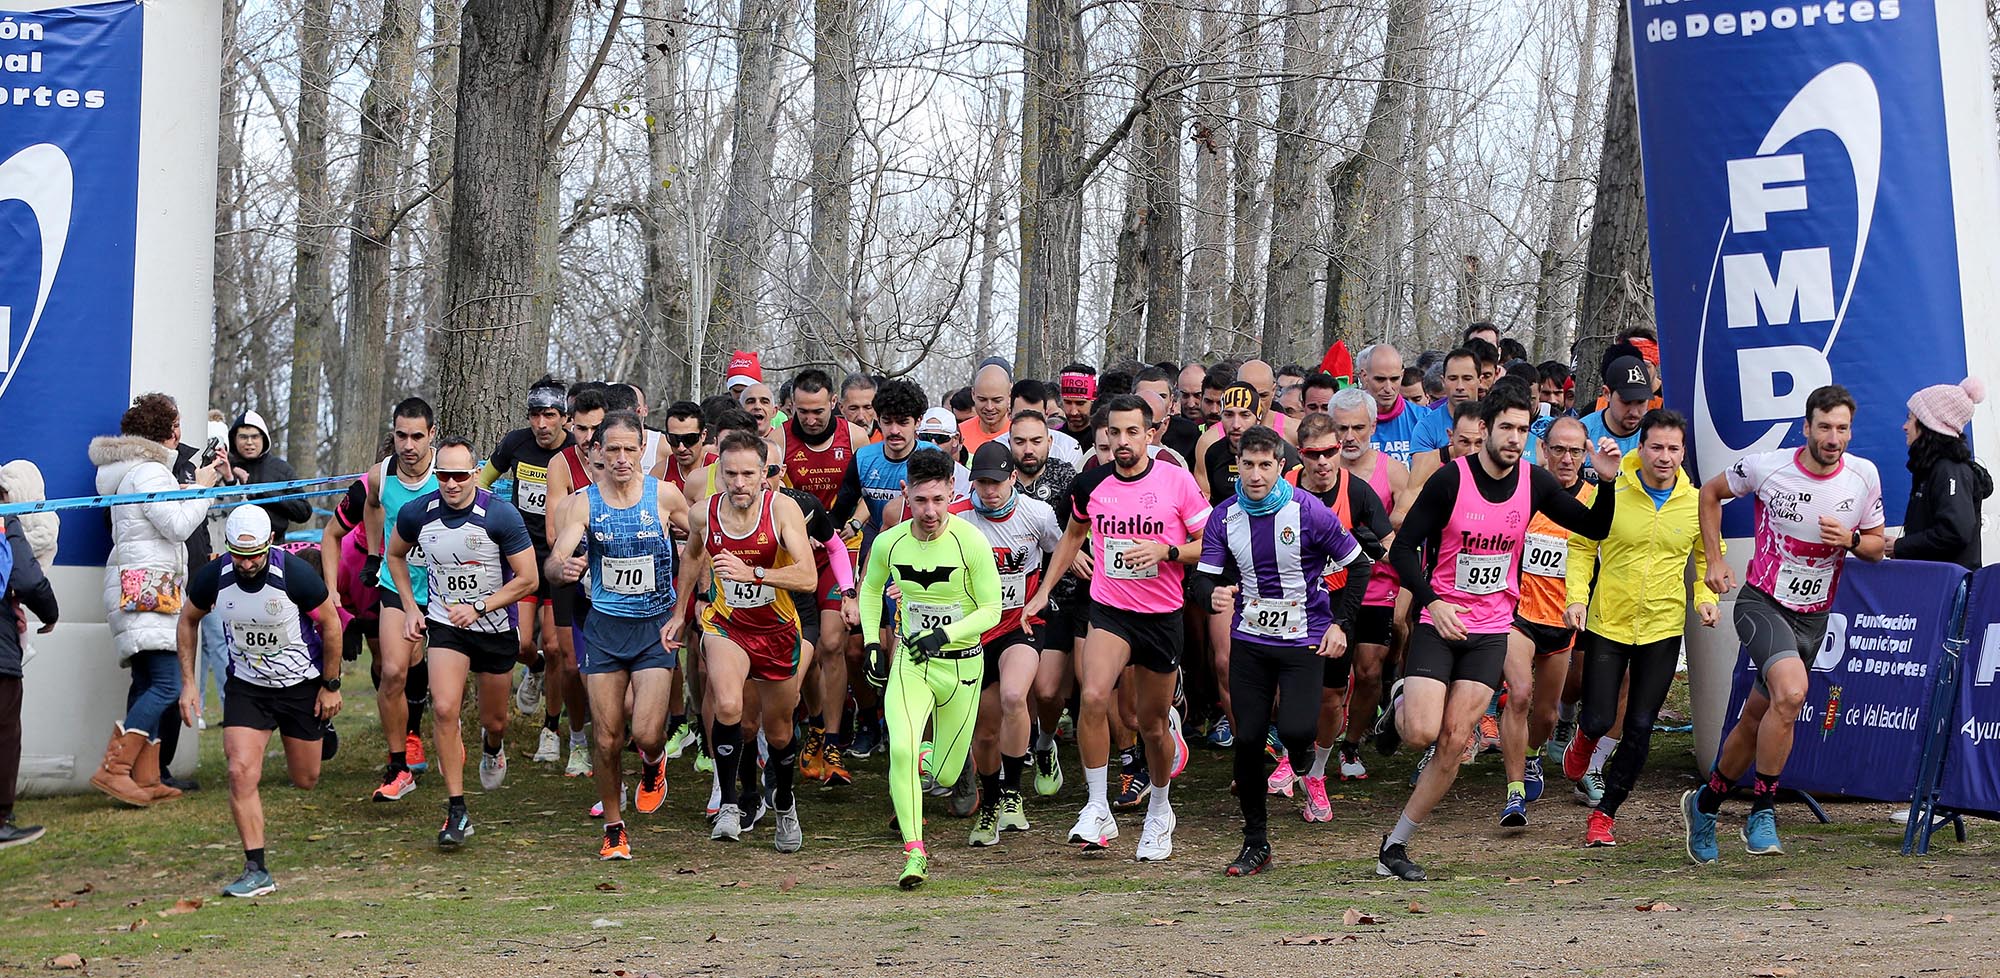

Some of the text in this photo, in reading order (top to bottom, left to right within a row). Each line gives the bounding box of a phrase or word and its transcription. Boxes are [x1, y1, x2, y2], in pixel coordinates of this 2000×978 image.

[1646, 0, 1900, 43] de Deportes
[0, 51, 42, 73] al
[1384, 441, 1410, 452] ARE
[1798, 492, 1812, 502] 10
[1096, 514, 1164, 535] Triatlón
[1461, 530, 1515, 552] Triatlón
[1529, 548, 1563, 568] 902
[447, 574, 478, 591] 863
[614, 568, 643, 586] 710
[1468, 566, 1502, 585] 939
[1788, 577, 1823, 596] 496
[1257, 610, 1289, 628] 821
[245, 631, 278, 647] 864
[1849, 635, 1912, 653] Municipal
[1847, 657, 1928, 677] de Deportes
